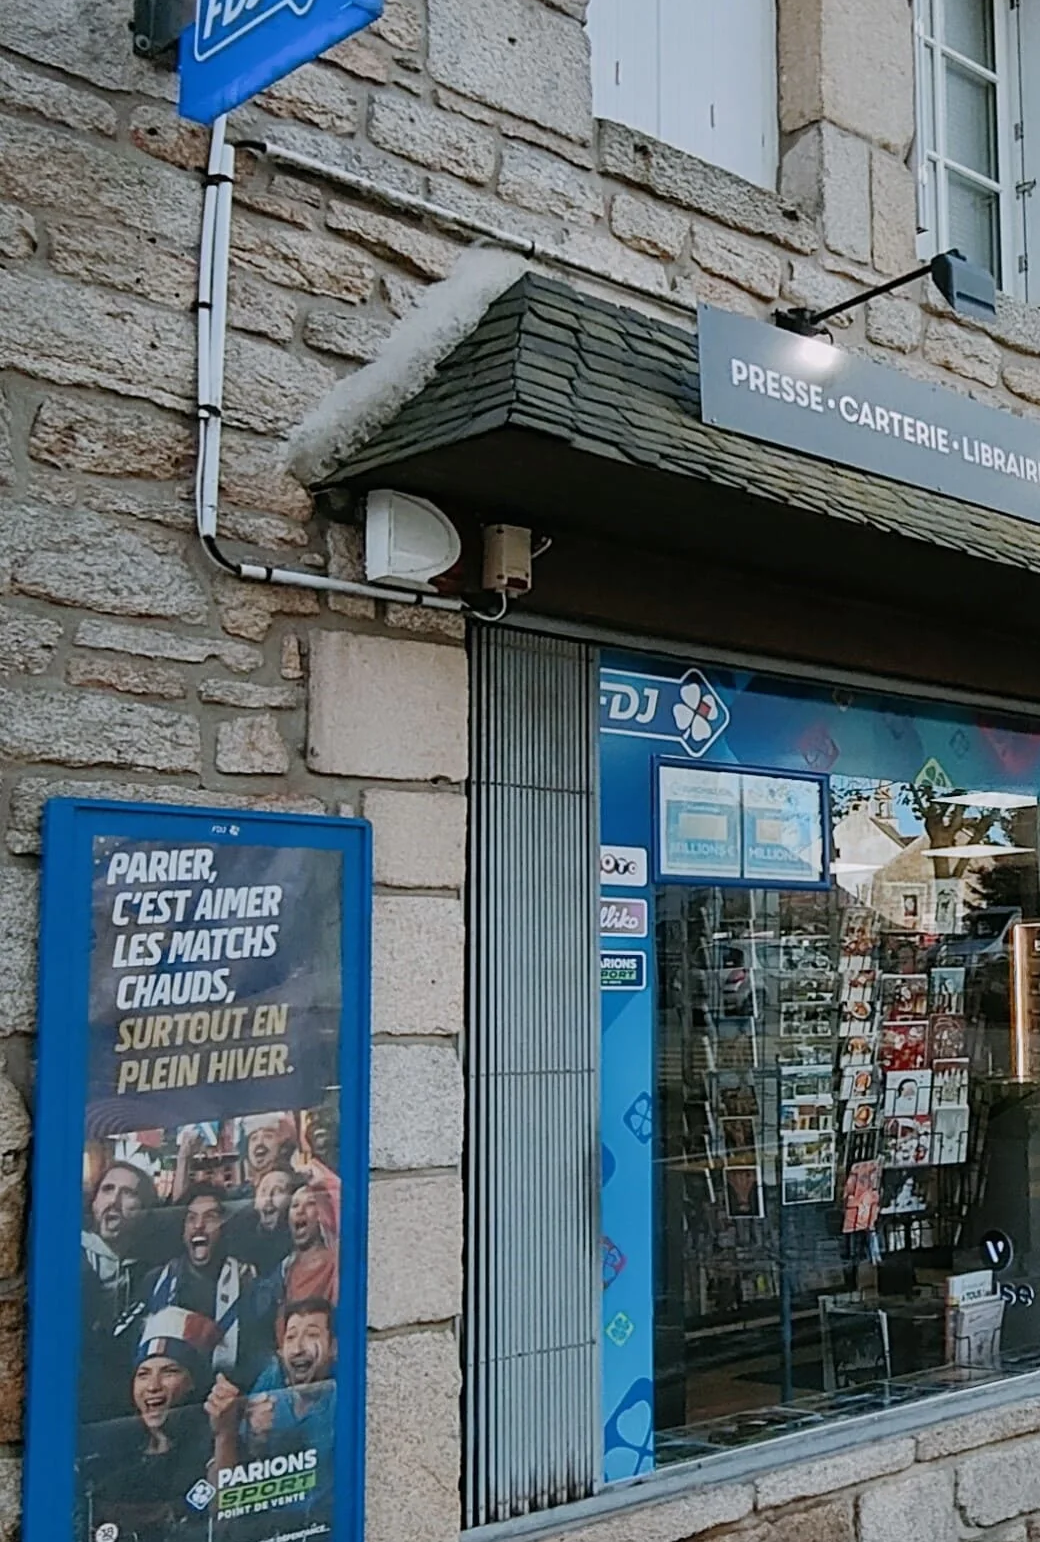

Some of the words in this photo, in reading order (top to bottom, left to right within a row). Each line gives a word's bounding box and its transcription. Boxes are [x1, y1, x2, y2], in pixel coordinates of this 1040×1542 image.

[731, 358, 824, 413] PRESSE
[839, 396, 950, 454] CARTERIE
[107, 848, 218, 885] PARIER,
[600, 854, 638, 875] OTO
[112, 889, 192, 926] C'EST
[194, 885, 283, 921] AIMER
[112, 931, 164, 968] LES
[167, 924, 280, 964] MATCHS
[116, 968, 236, 1010] CHAUDS,
[114, 1006, 249, 1052] SURTOUT
[252, 1003, 289, 1037] EN
[117, 1052, 200, 1094] PLEIN
[206, 1043, 295, 1084] HIVER.
[218, 1448, 317, 1489] PARIONS
[217, 1504, 251, 1521] POINT
[253, 1500, 269, 1513] DE
[271, 1491, 306, 1508] VENTE
[221, 1473, 314, 1506] SPORT
